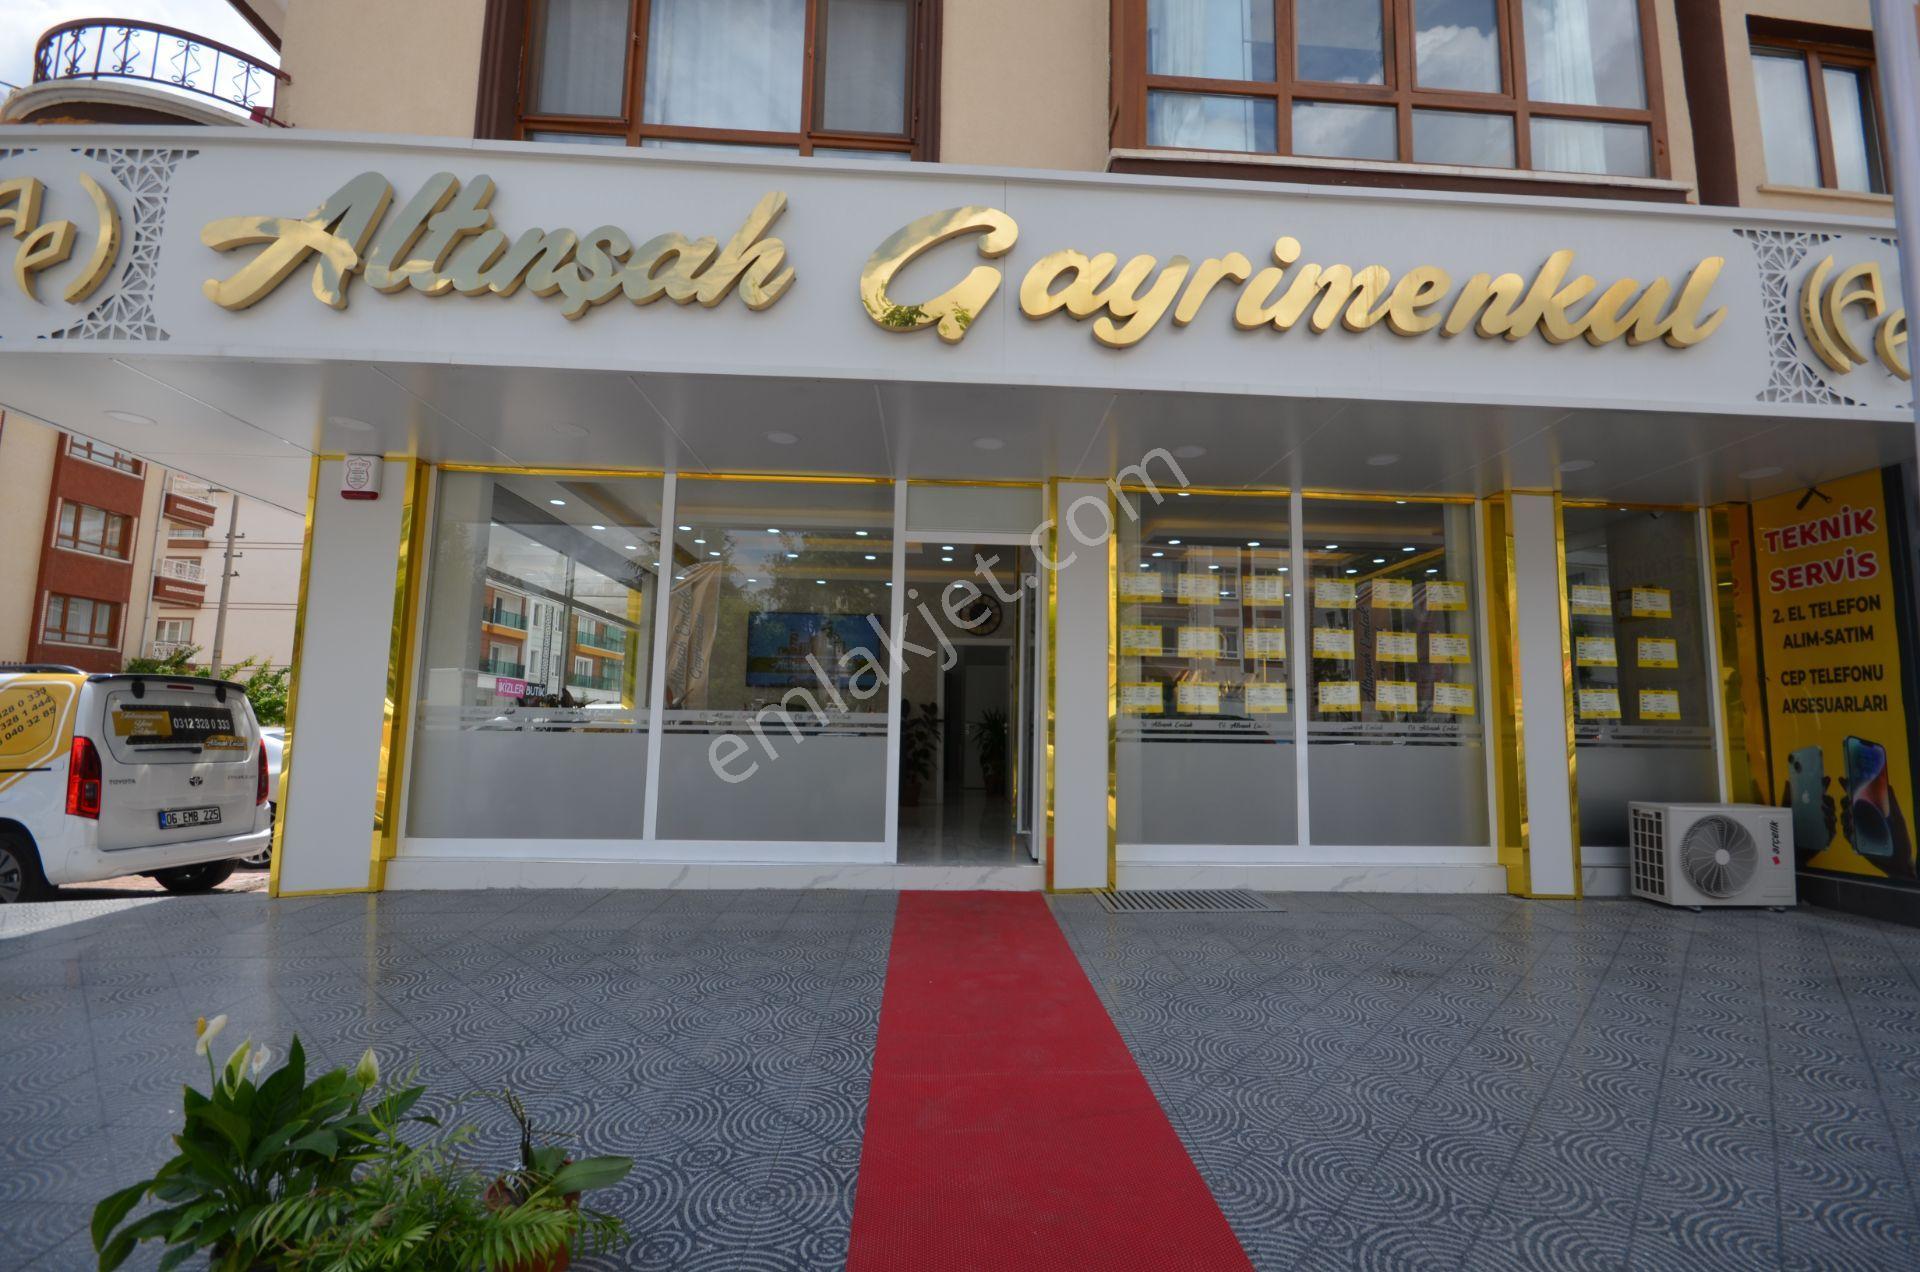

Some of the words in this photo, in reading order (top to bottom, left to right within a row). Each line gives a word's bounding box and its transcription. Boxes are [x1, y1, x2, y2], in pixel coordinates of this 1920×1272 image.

[201, 171, 795, 321] Altınşah
[860, 205, 1729, 349] Gayrimenkul
[1764, 506, 1877, 553] TEKNİK
[1770, 548, 1878, 593] SERVİS
[1772, 609, 1785, 624] 2.
[1788, 606, 1806, 621] EL
[1808, 595, 1881, 619] TELEFON
[1783, 625, 1874, 650] ALIM-SATIM
[1780, 669, 1806, 686] CEP
[1808, 664, 1883, 685] TELEFONU
[1782, 694, 1888, 715] AKSESUARLARI
[173, 717, 194, 729] 0312
[196, 718, 210, 729] 328
[166, 813, 178, 825] 06
[183, 811, 199, 823] EMB
[203, 809, 219, 821] 225
